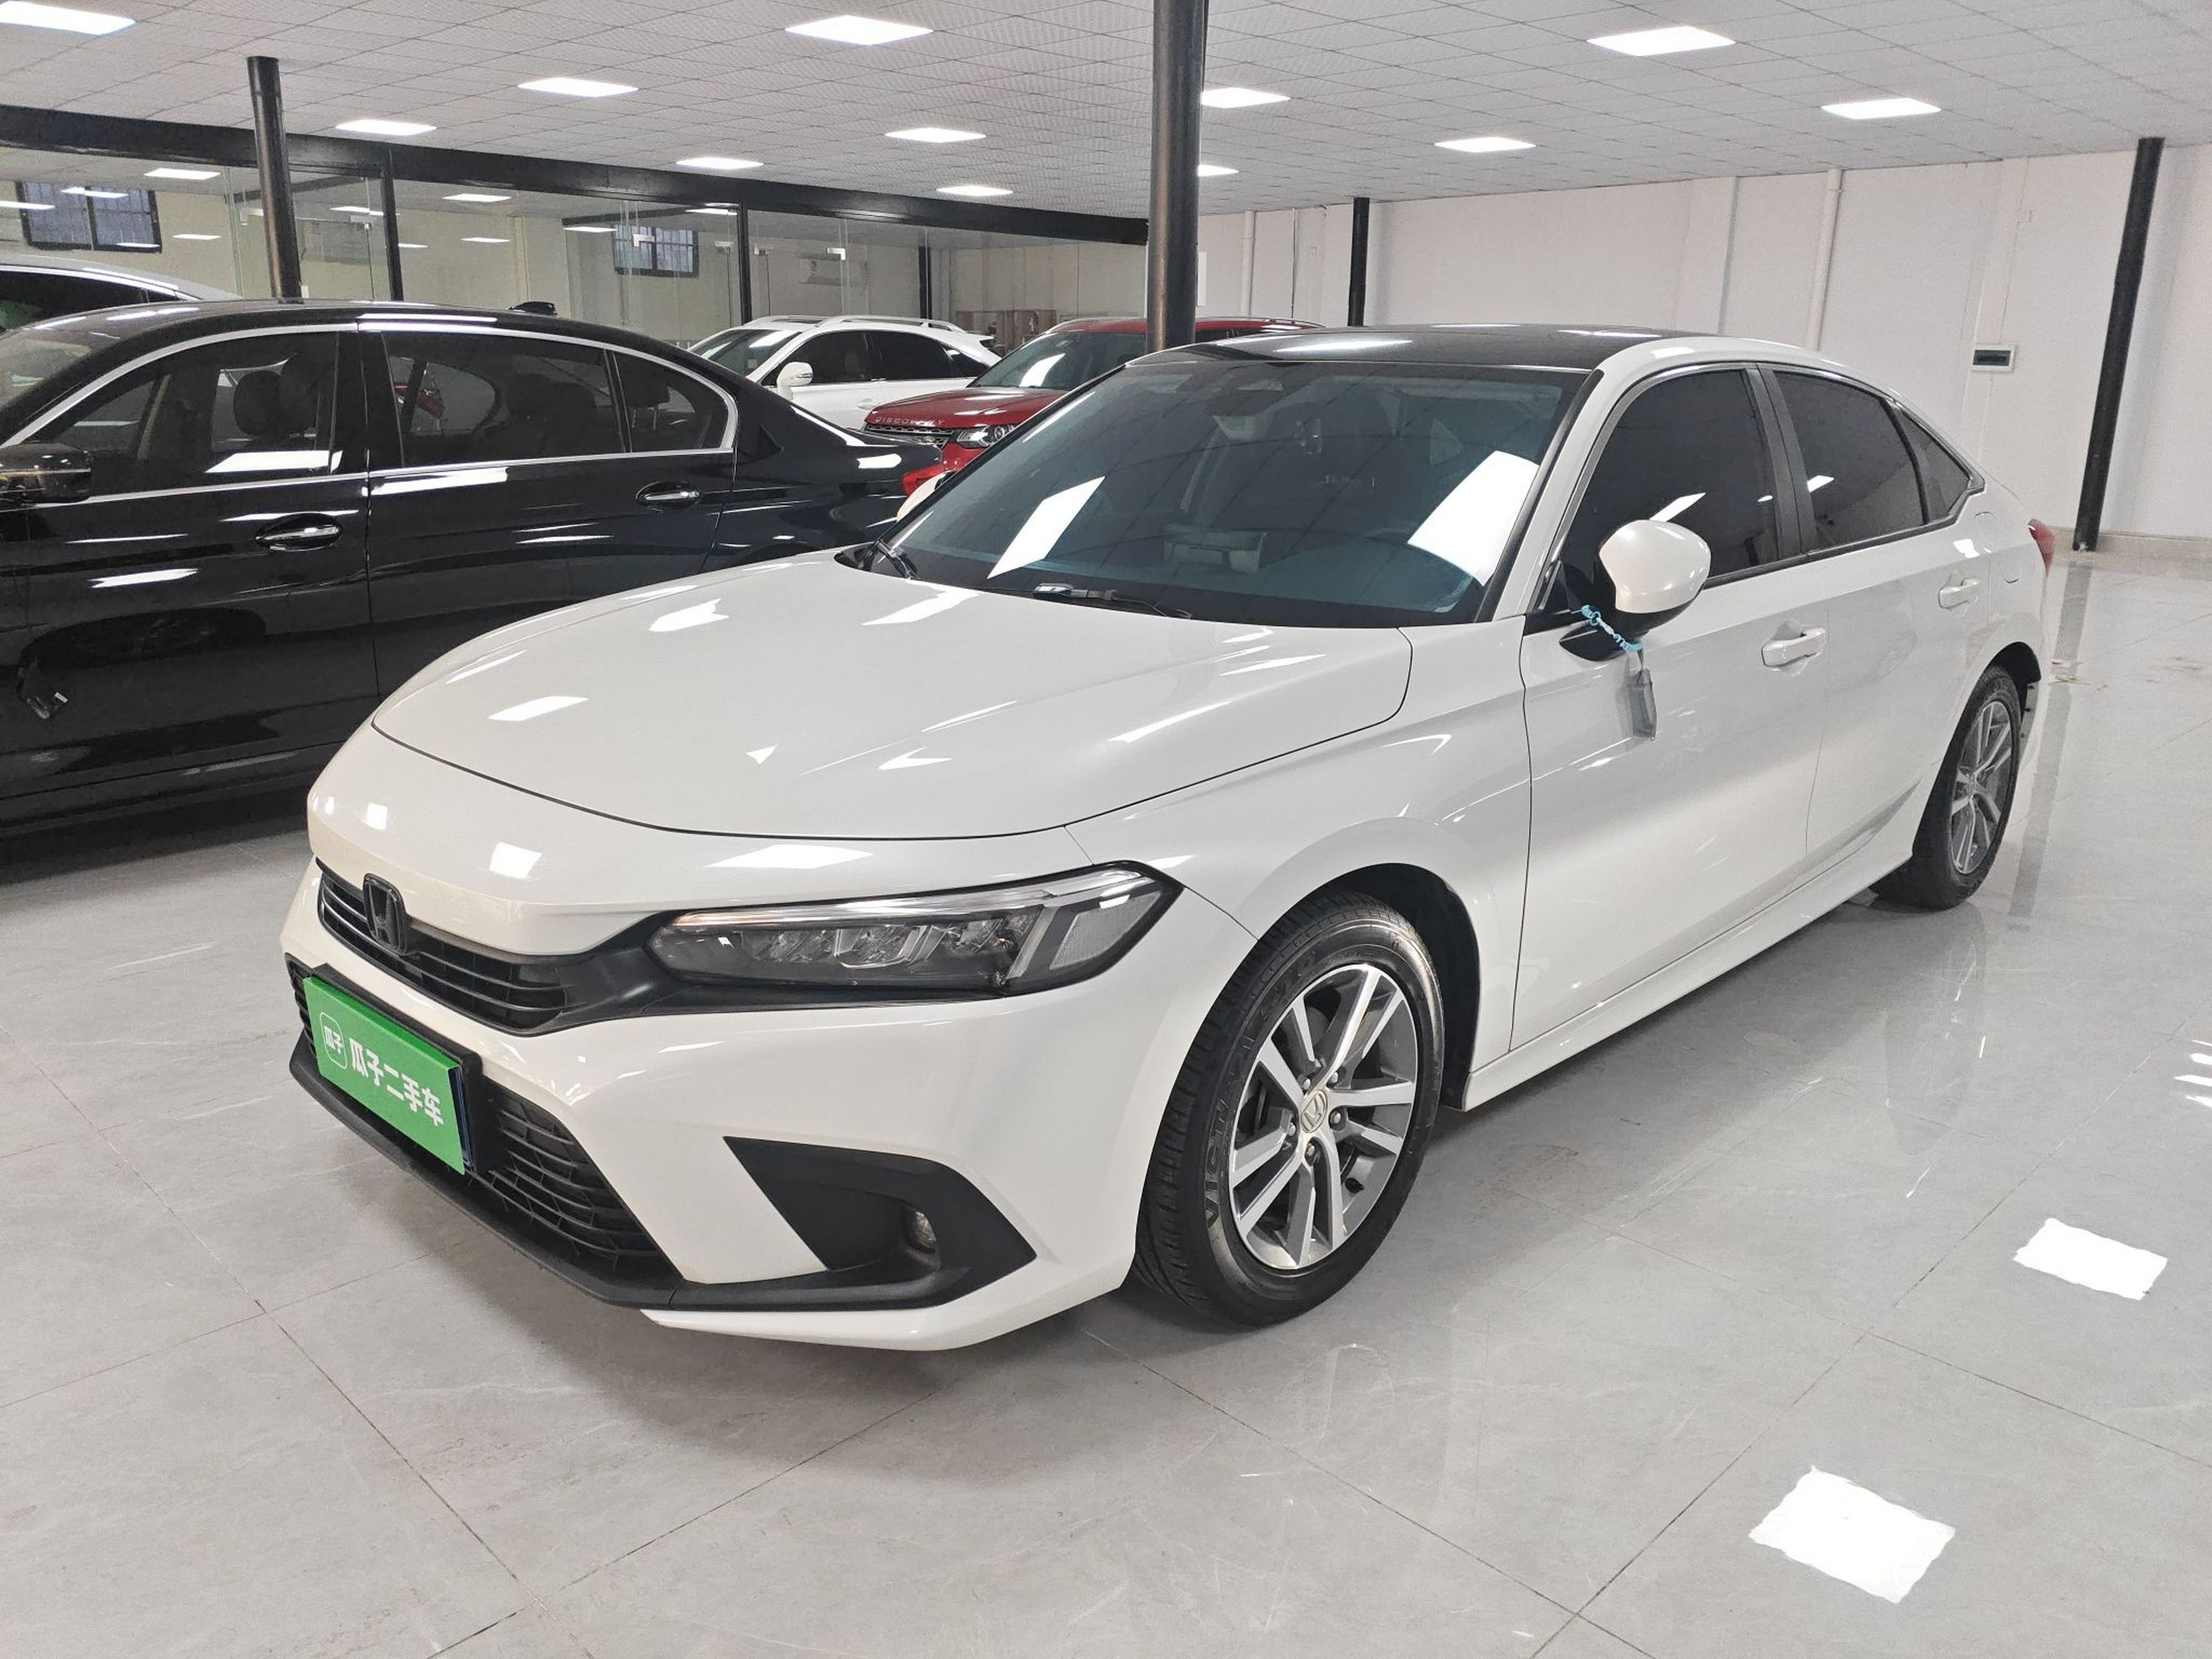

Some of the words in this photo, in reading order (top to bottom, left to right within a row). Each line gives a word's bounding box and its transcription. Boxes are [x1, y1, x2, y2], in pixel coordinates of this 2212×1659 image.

[875, 416, 945, 425] DISCOVRY
[349, 1037, 444, 1127] 瓜子二手车
